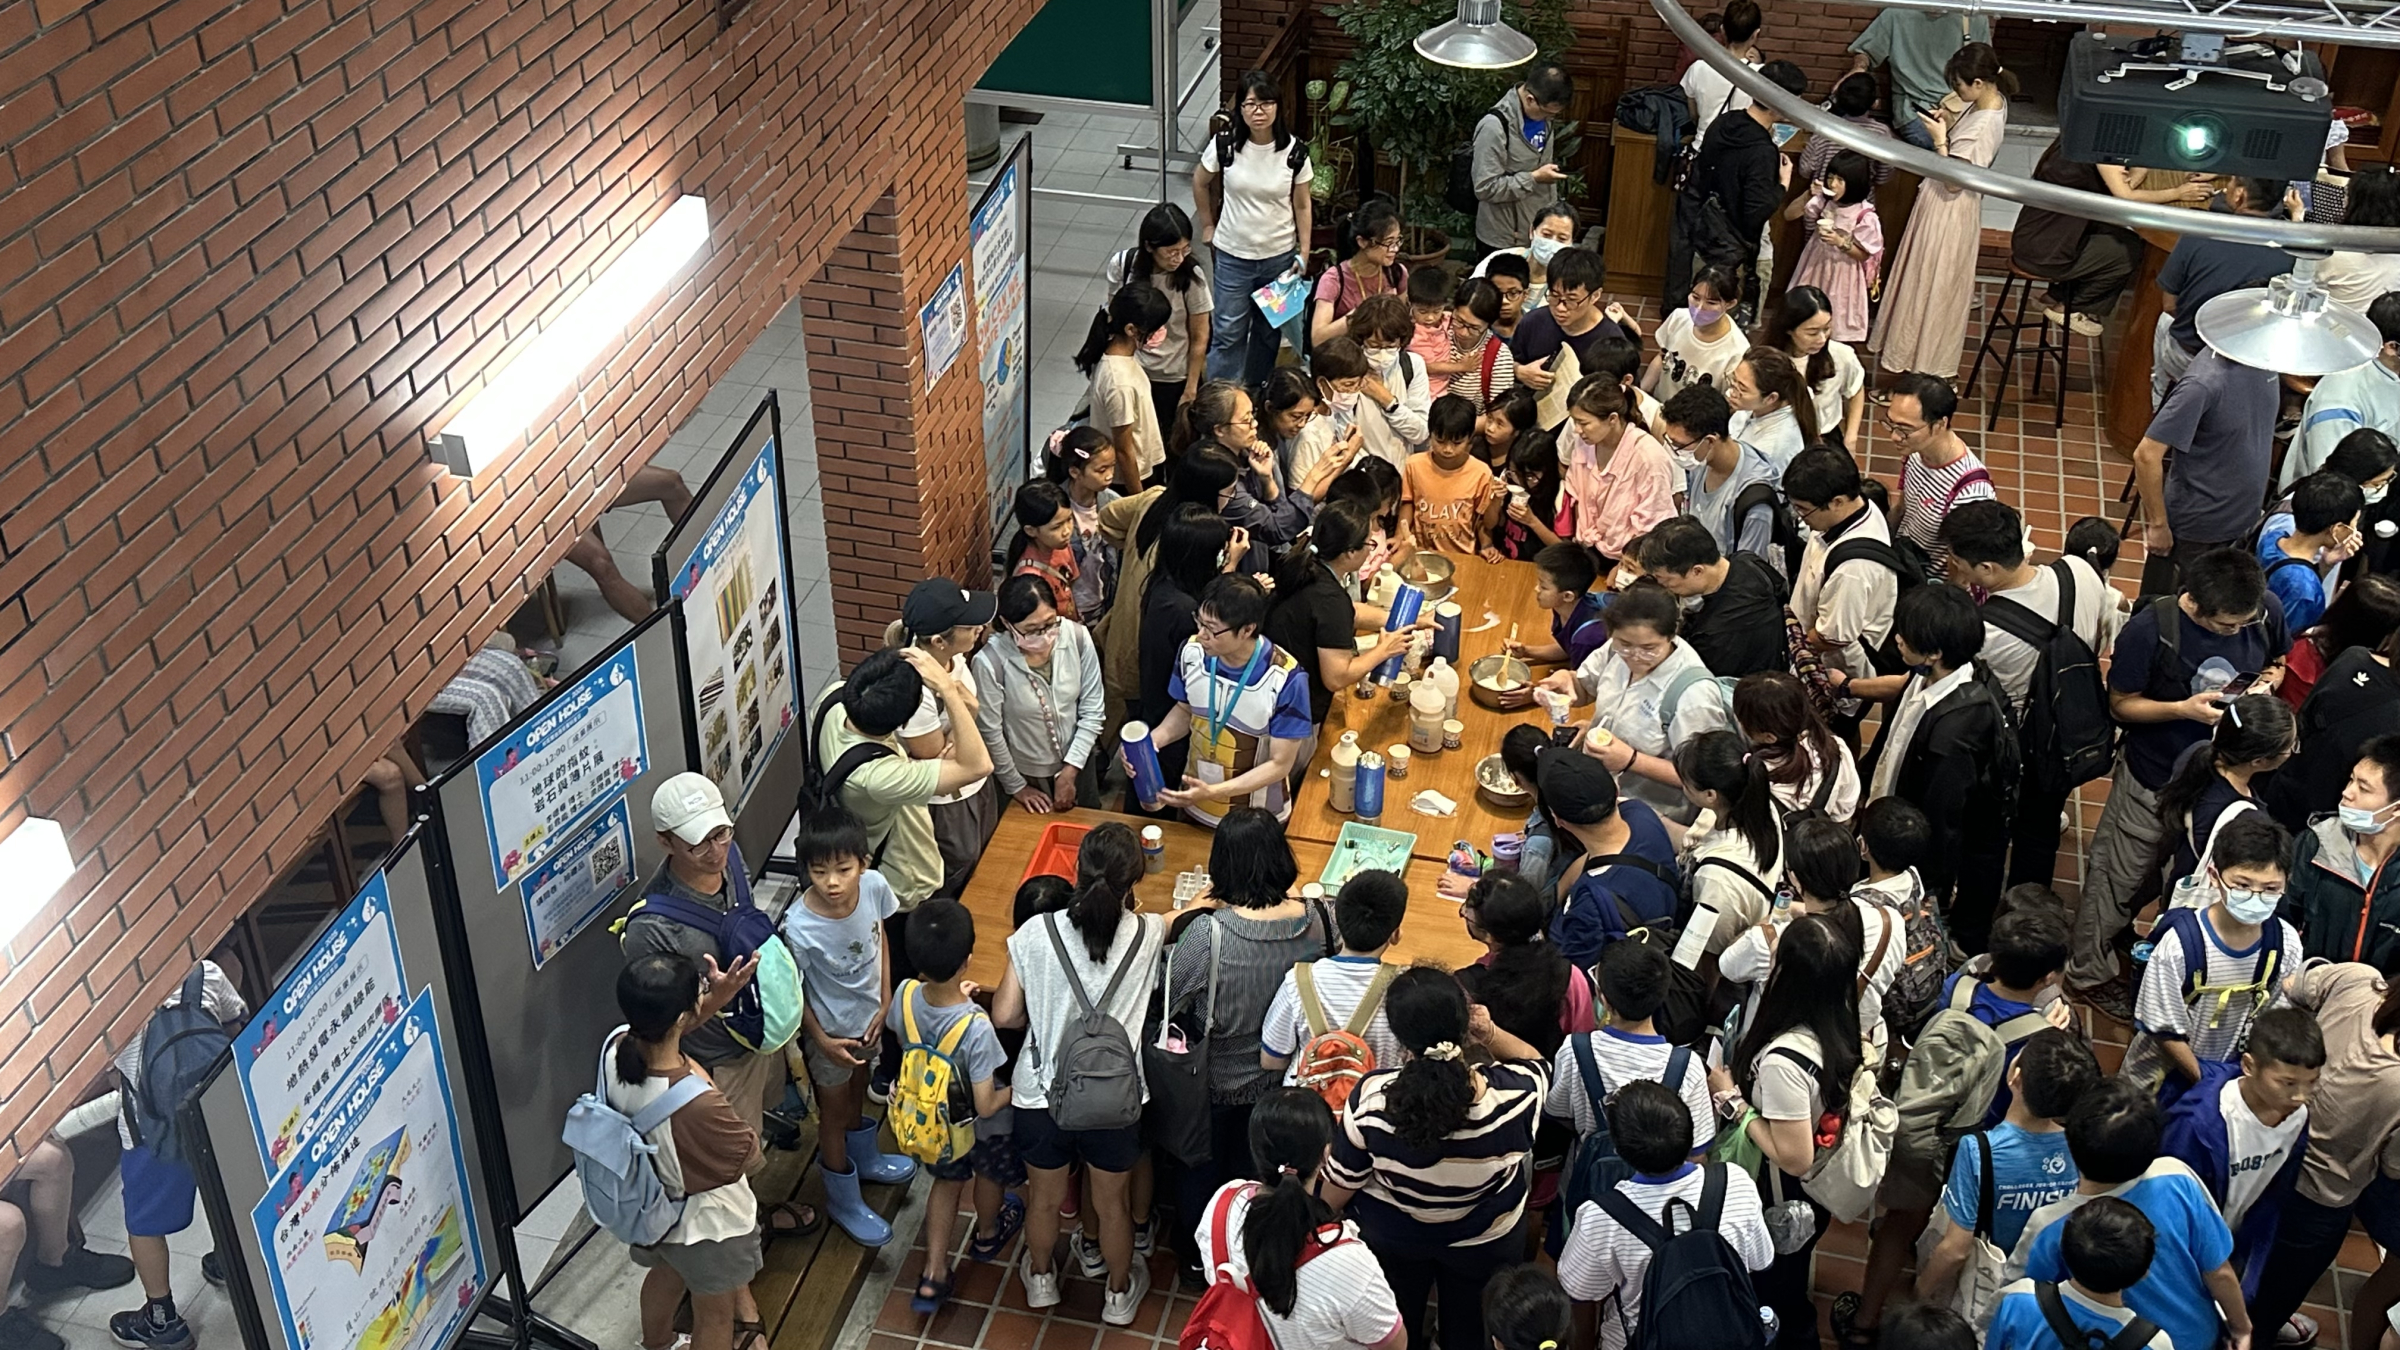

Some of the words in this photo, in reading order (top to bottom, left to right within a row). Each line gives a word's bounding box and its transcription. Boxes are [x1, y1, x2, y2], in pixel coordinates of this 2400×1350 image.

[703, 522, 724, 560] OPEN
[724, 487, 747, 530] HOUSE
[1419, 498, 1464, 520] PLAY
[526, 715, 557, 747] OPEN
[558, 686, 594, 723] HOUSE
[519, 743, 567, 786] 11:00-12:00
[534, 750, 604, 813] 岩石與薄片展
[524, 829, 543, 847] 主講人
[553, 850, 573, 871] OPEN
[573, 829, 597, 853] HOUSE
[283, 973, 312, 1014] OPEN
[312, 930, 347, 979] HOUSE
[286, 1002, 328, 1060] 11:00-12:00
[287, 976, 376, 1092] 地熱發電永續綠能
[311, 1111, 346, 1162] OPEN
[347, 1058, 386, 1117] HOUSE
